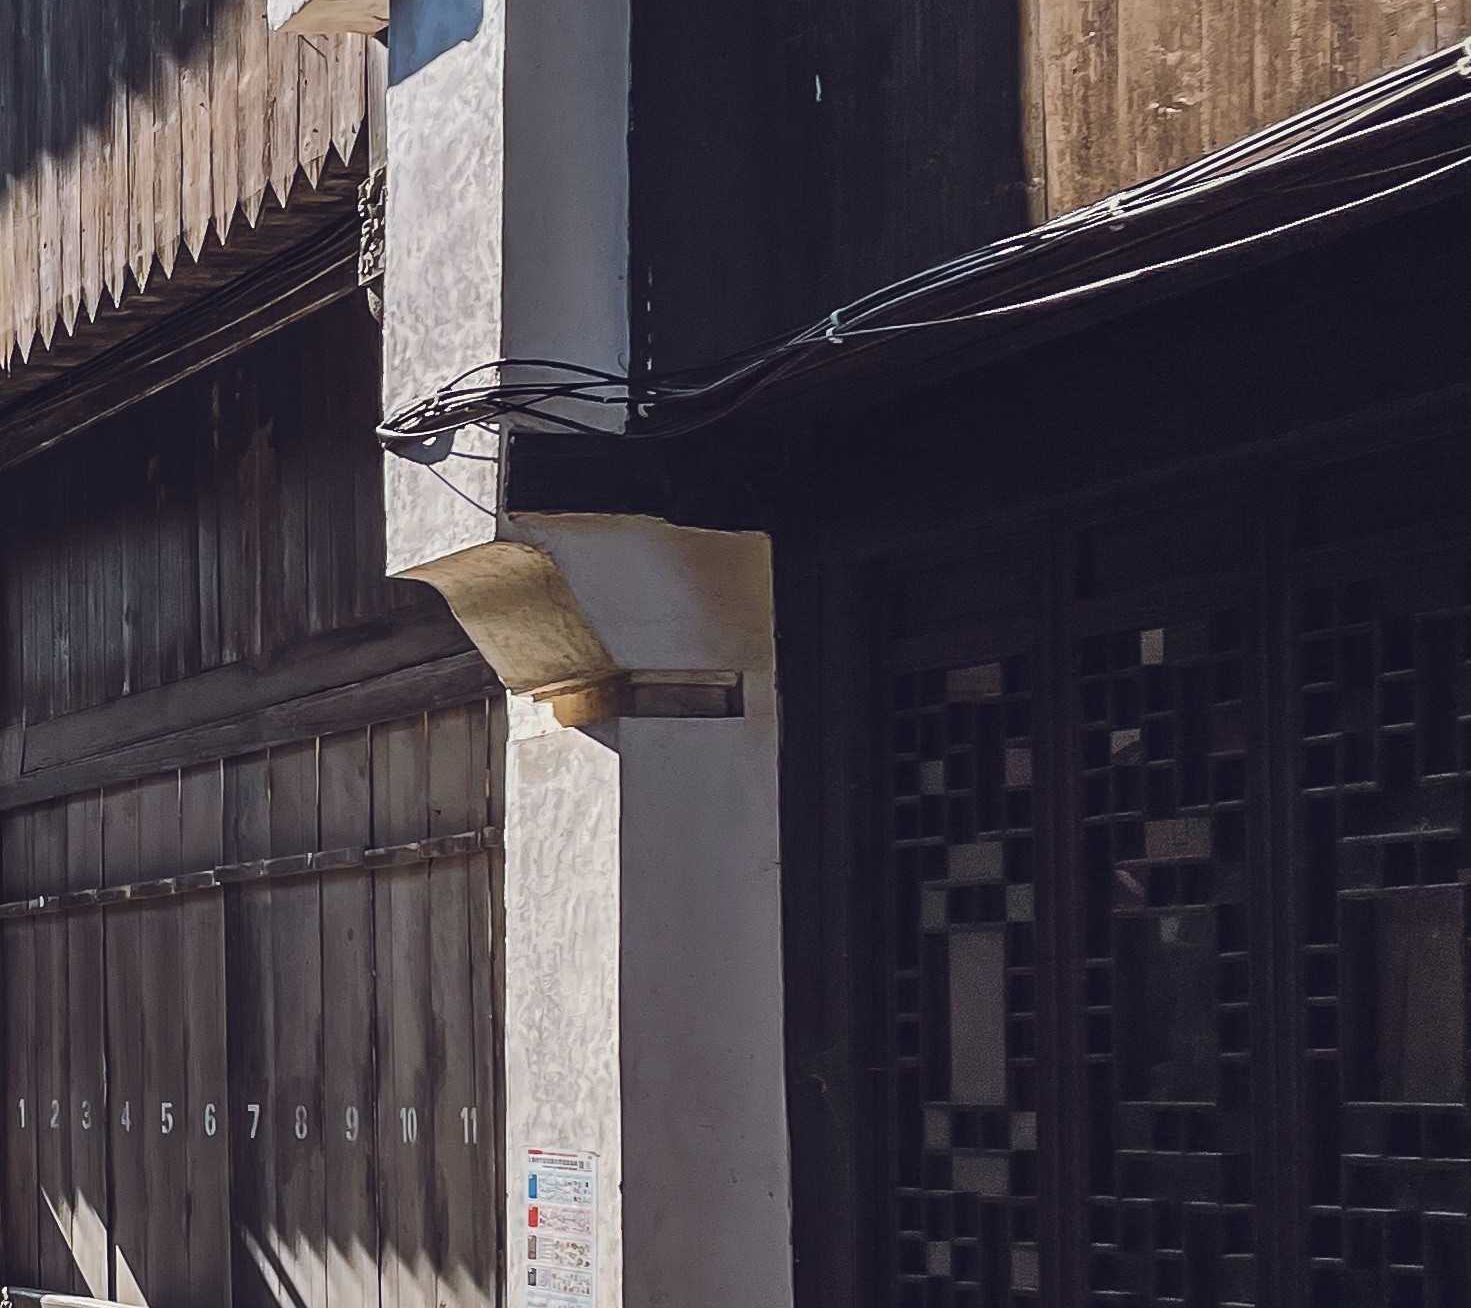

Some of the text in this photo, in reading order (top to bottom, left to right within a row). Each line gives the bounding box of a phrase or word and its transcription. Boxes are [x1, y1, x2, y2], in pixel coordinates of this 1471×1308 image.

[18, 1098, 478, 1145] 1 2 3 4 5 6 7 8 9 10 11
